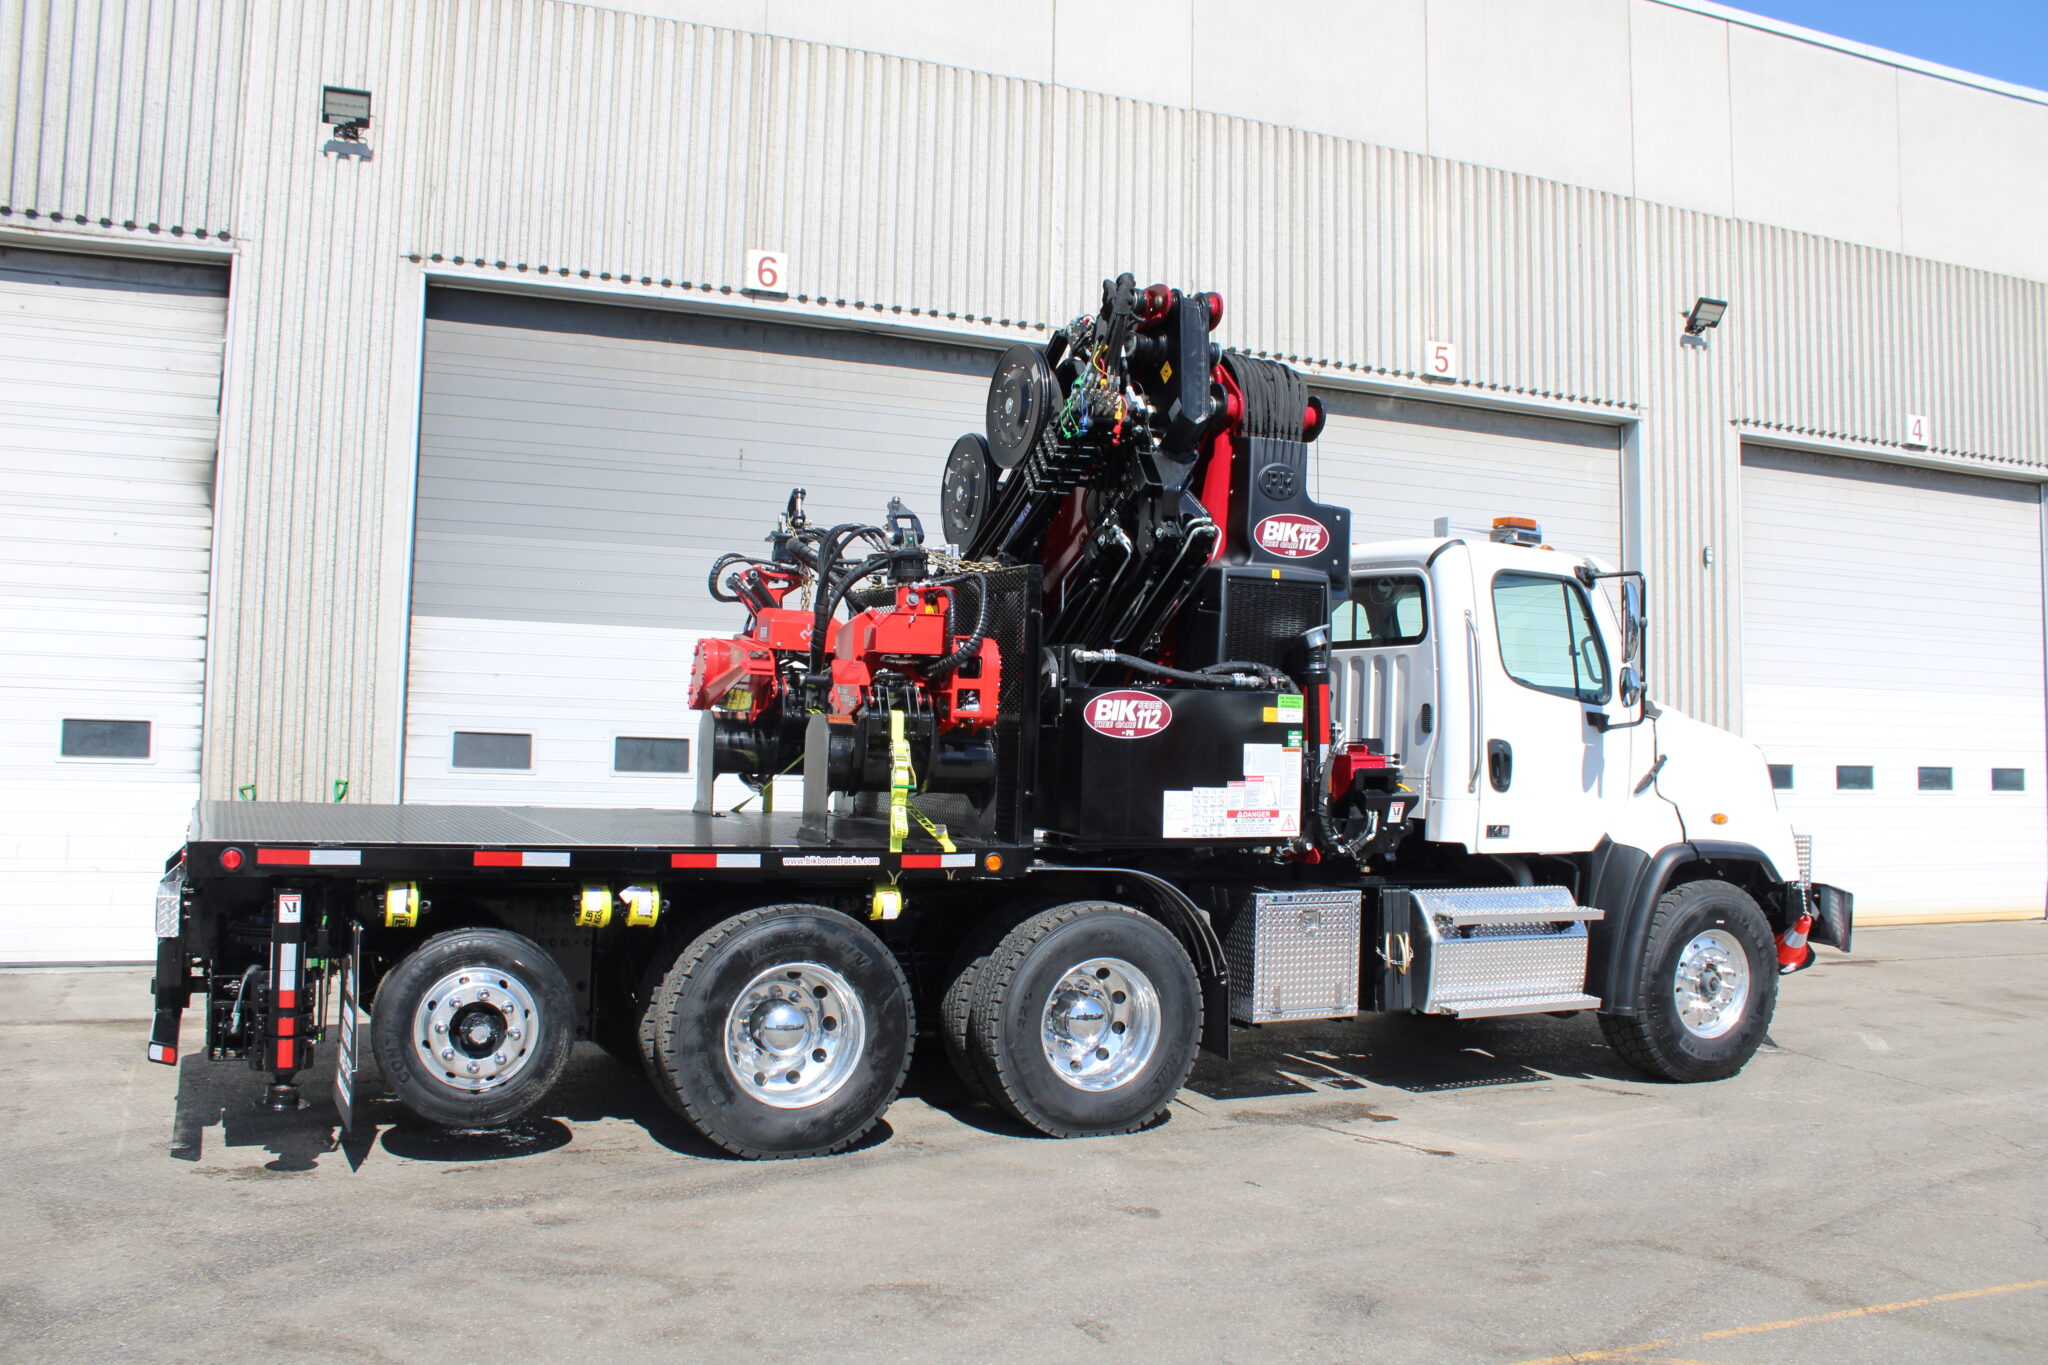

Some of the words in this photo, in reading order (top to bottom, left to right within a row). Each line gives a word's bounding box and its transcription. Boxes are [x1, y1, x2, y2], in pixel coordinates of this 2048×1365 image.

[757, 256, 778, 288] 6
[1434, 346, 1449, 374] 5
[1911, 419, 1923, 442] 4
[1262, 520, 1302, 543] BIK
[1299, 532, 1320, 551] 112
[1094, 699, 1139, 721] BIK
[1137, 700, 1163, 709] SERIES
[1136, 709, 1162, 729] 112
[783, 855, 880, 866] www.bikboomtrucks.com
